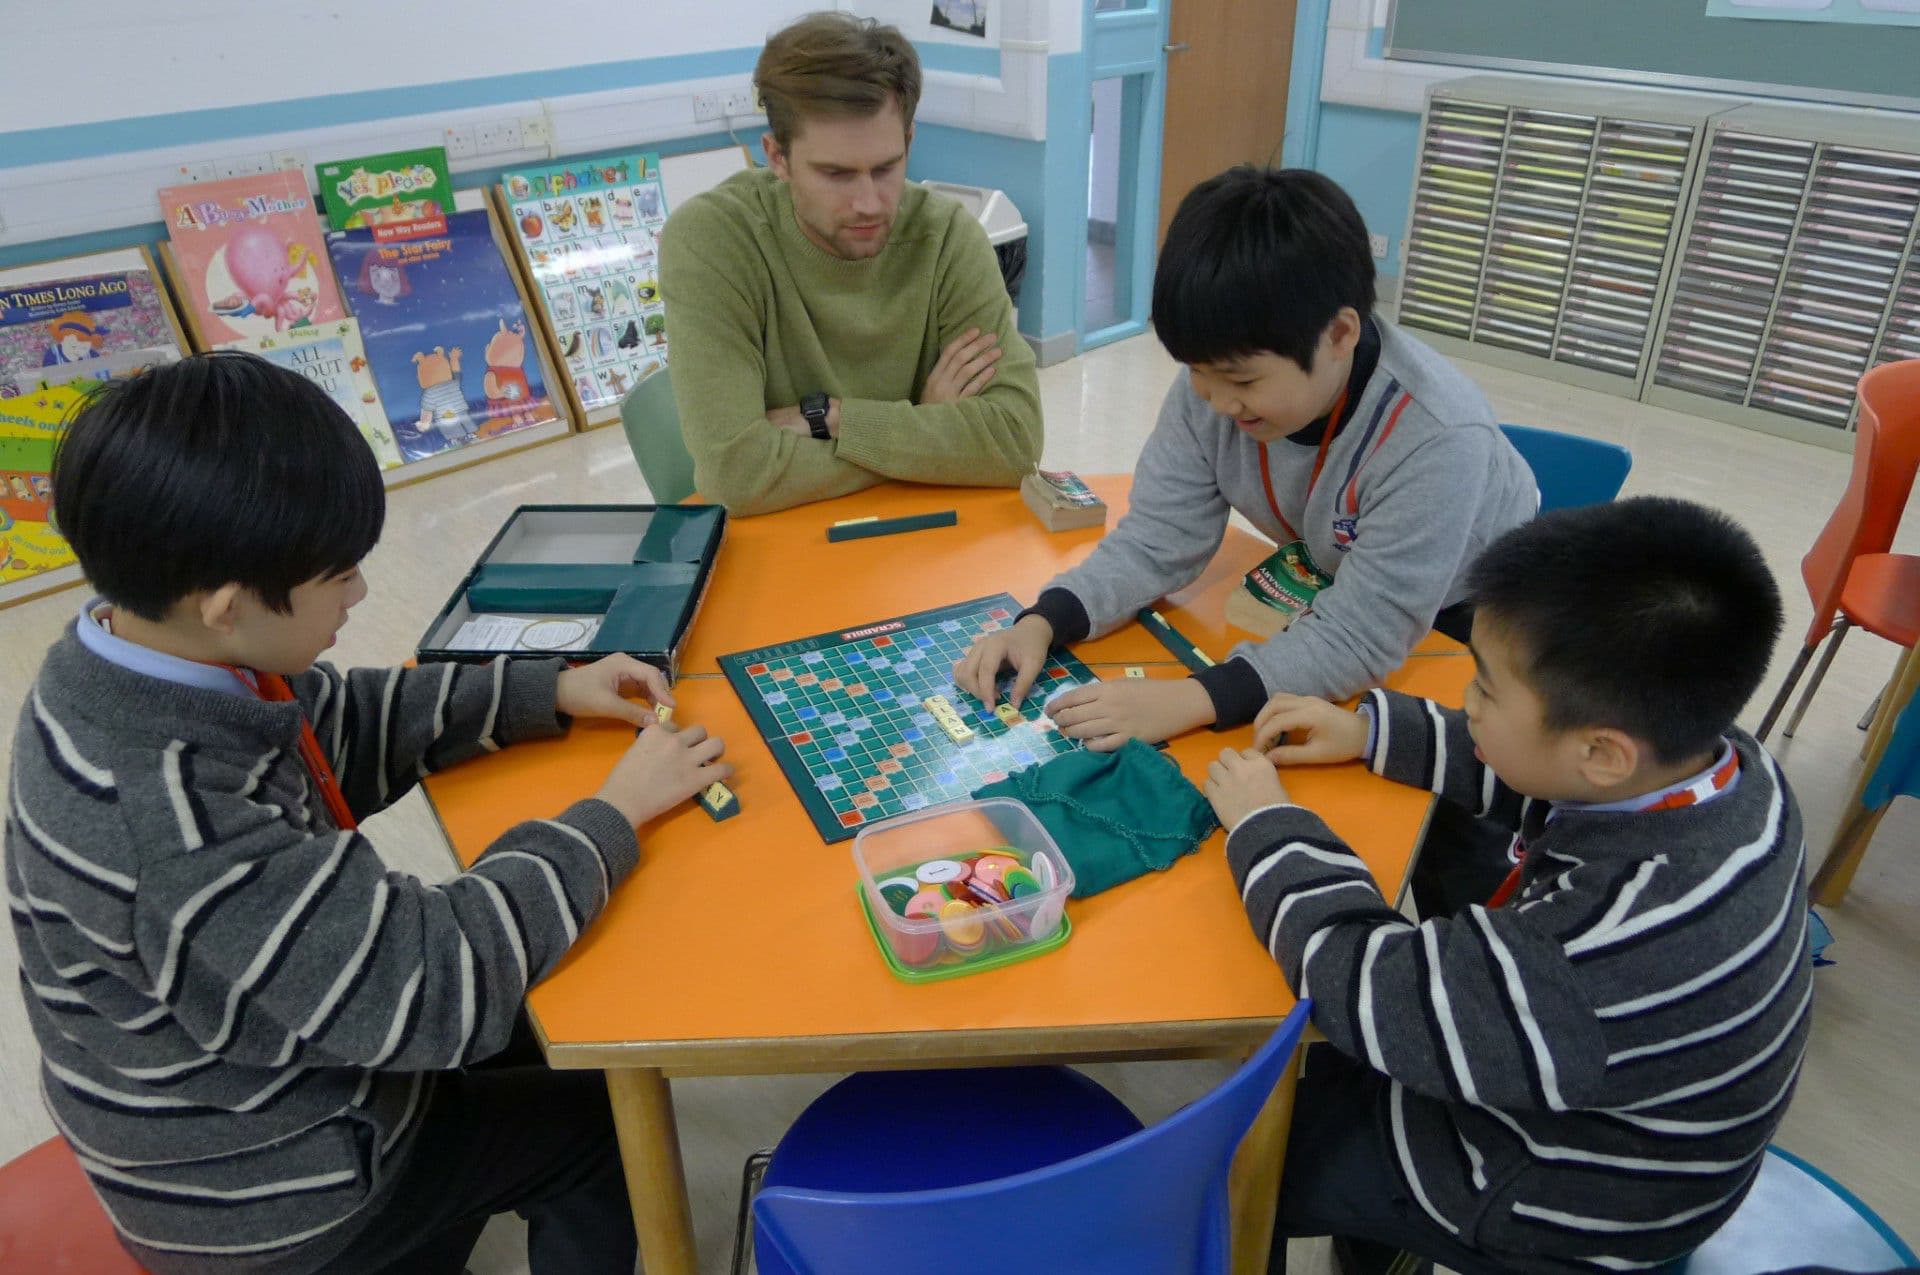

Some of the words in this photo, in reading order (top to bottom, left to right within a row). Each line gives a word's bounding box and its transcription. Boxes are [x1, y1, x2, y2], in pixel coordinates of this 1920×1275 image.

[177, 203, 198, 227] A
[11, 291, 55, 308] TIMES
[56, 285, 96, 301] LONG
[99, 280, 127, 296] AGO
[291, 345, 328, 366] ALL
